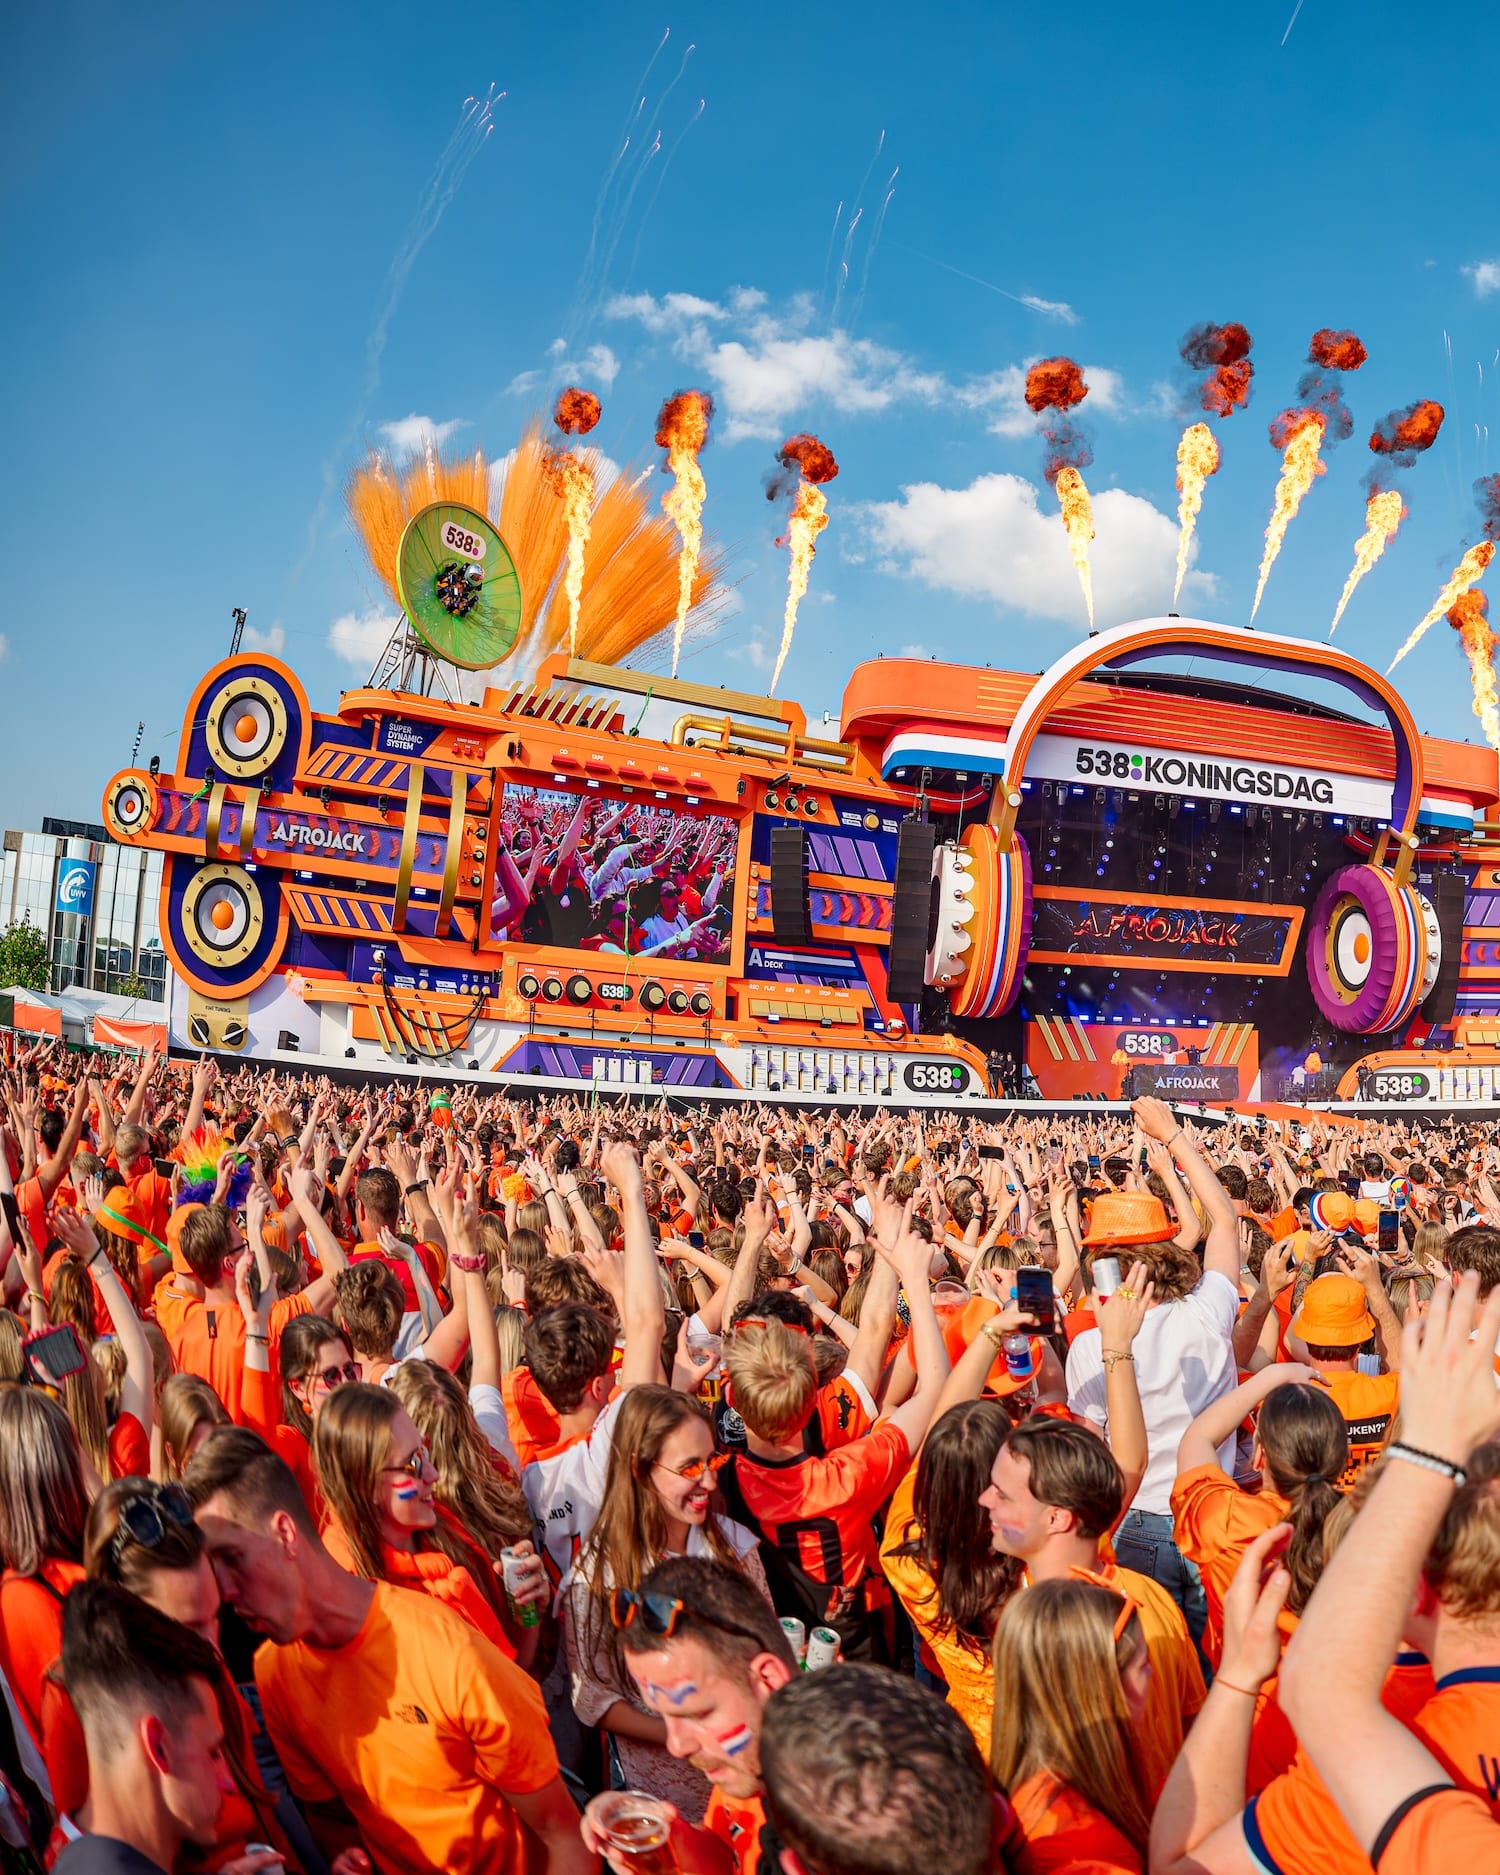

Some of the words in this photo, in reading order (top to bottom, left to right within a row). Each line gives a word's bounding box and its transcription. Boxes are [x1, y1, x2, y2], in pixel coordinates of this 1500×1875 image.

[446, 526, 474, 553] 538
[389, 723, 412, 735] SUPER
[386, 739, 414, 751] SYSTEM
[387, 731, 423, 745] DYNAMIC
[1076, 747, 1130, 780] 538
[1144, 756, 1334, 804] KONINGSDAG
[272, 821, 365, 852] AFROJACK
[70, 888, 87, 900] UWV
[1072, 910, 1241, 947] AFROJACK
[764, 960, 784, 969] DECK
[601, 984, 625, 998] 538
[1124, 1034, 1162, 1054] 538
[912, 1065, 953, 1089] 538
[1154, 1075, 1220, 1090] AFROJACK
[1375, 1076, 1413, 1095] 538
